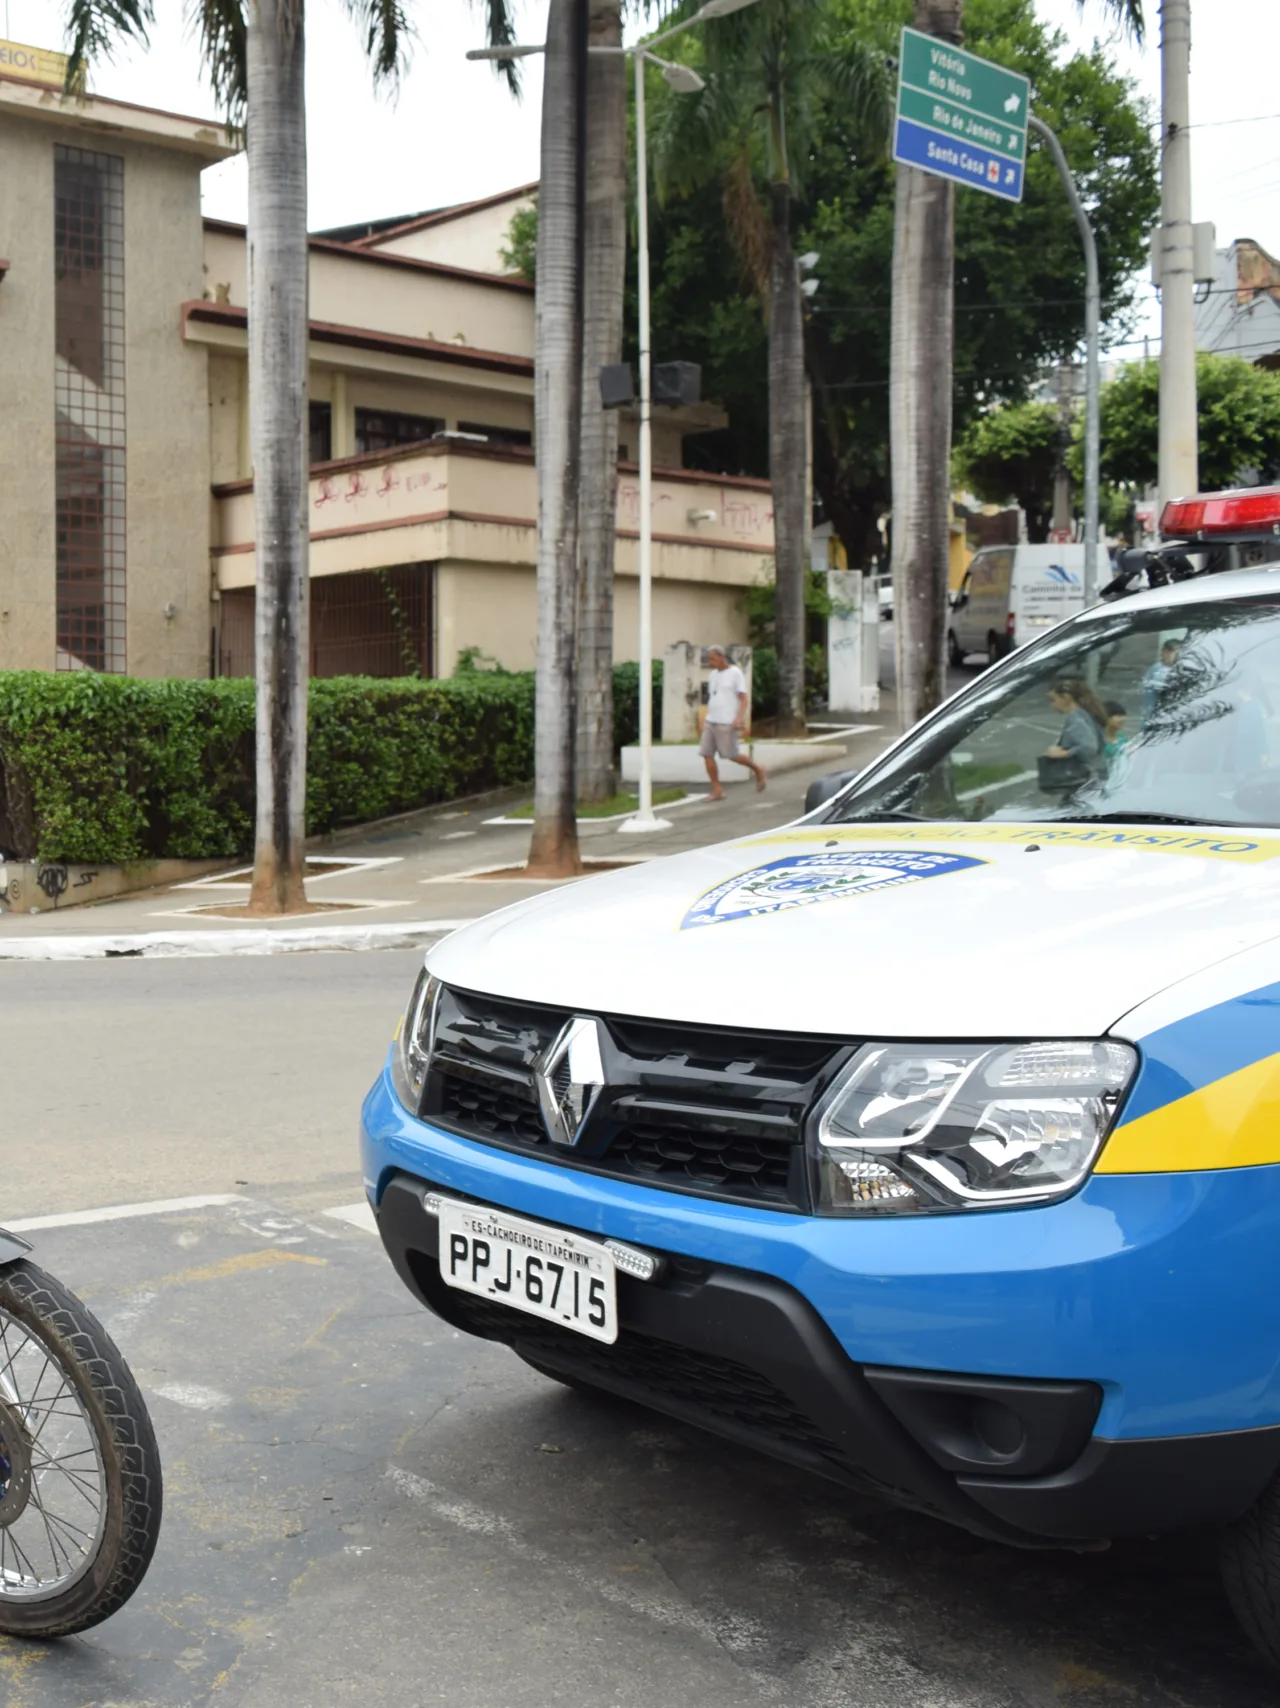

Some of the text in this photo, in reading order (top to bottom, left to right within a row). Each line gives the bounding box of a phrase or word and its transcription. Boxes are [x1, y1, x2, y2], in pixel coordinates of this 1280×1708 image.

[931, 49, 965, 76] Vitória
[928, 70, 972, 100] Rio Novo
[933, 105, 1002, 144] Rio de Janeiro
[927, 142, 985, 175] Santa Casa
[1010, 830, 1259, 853] TRÂNSITO
